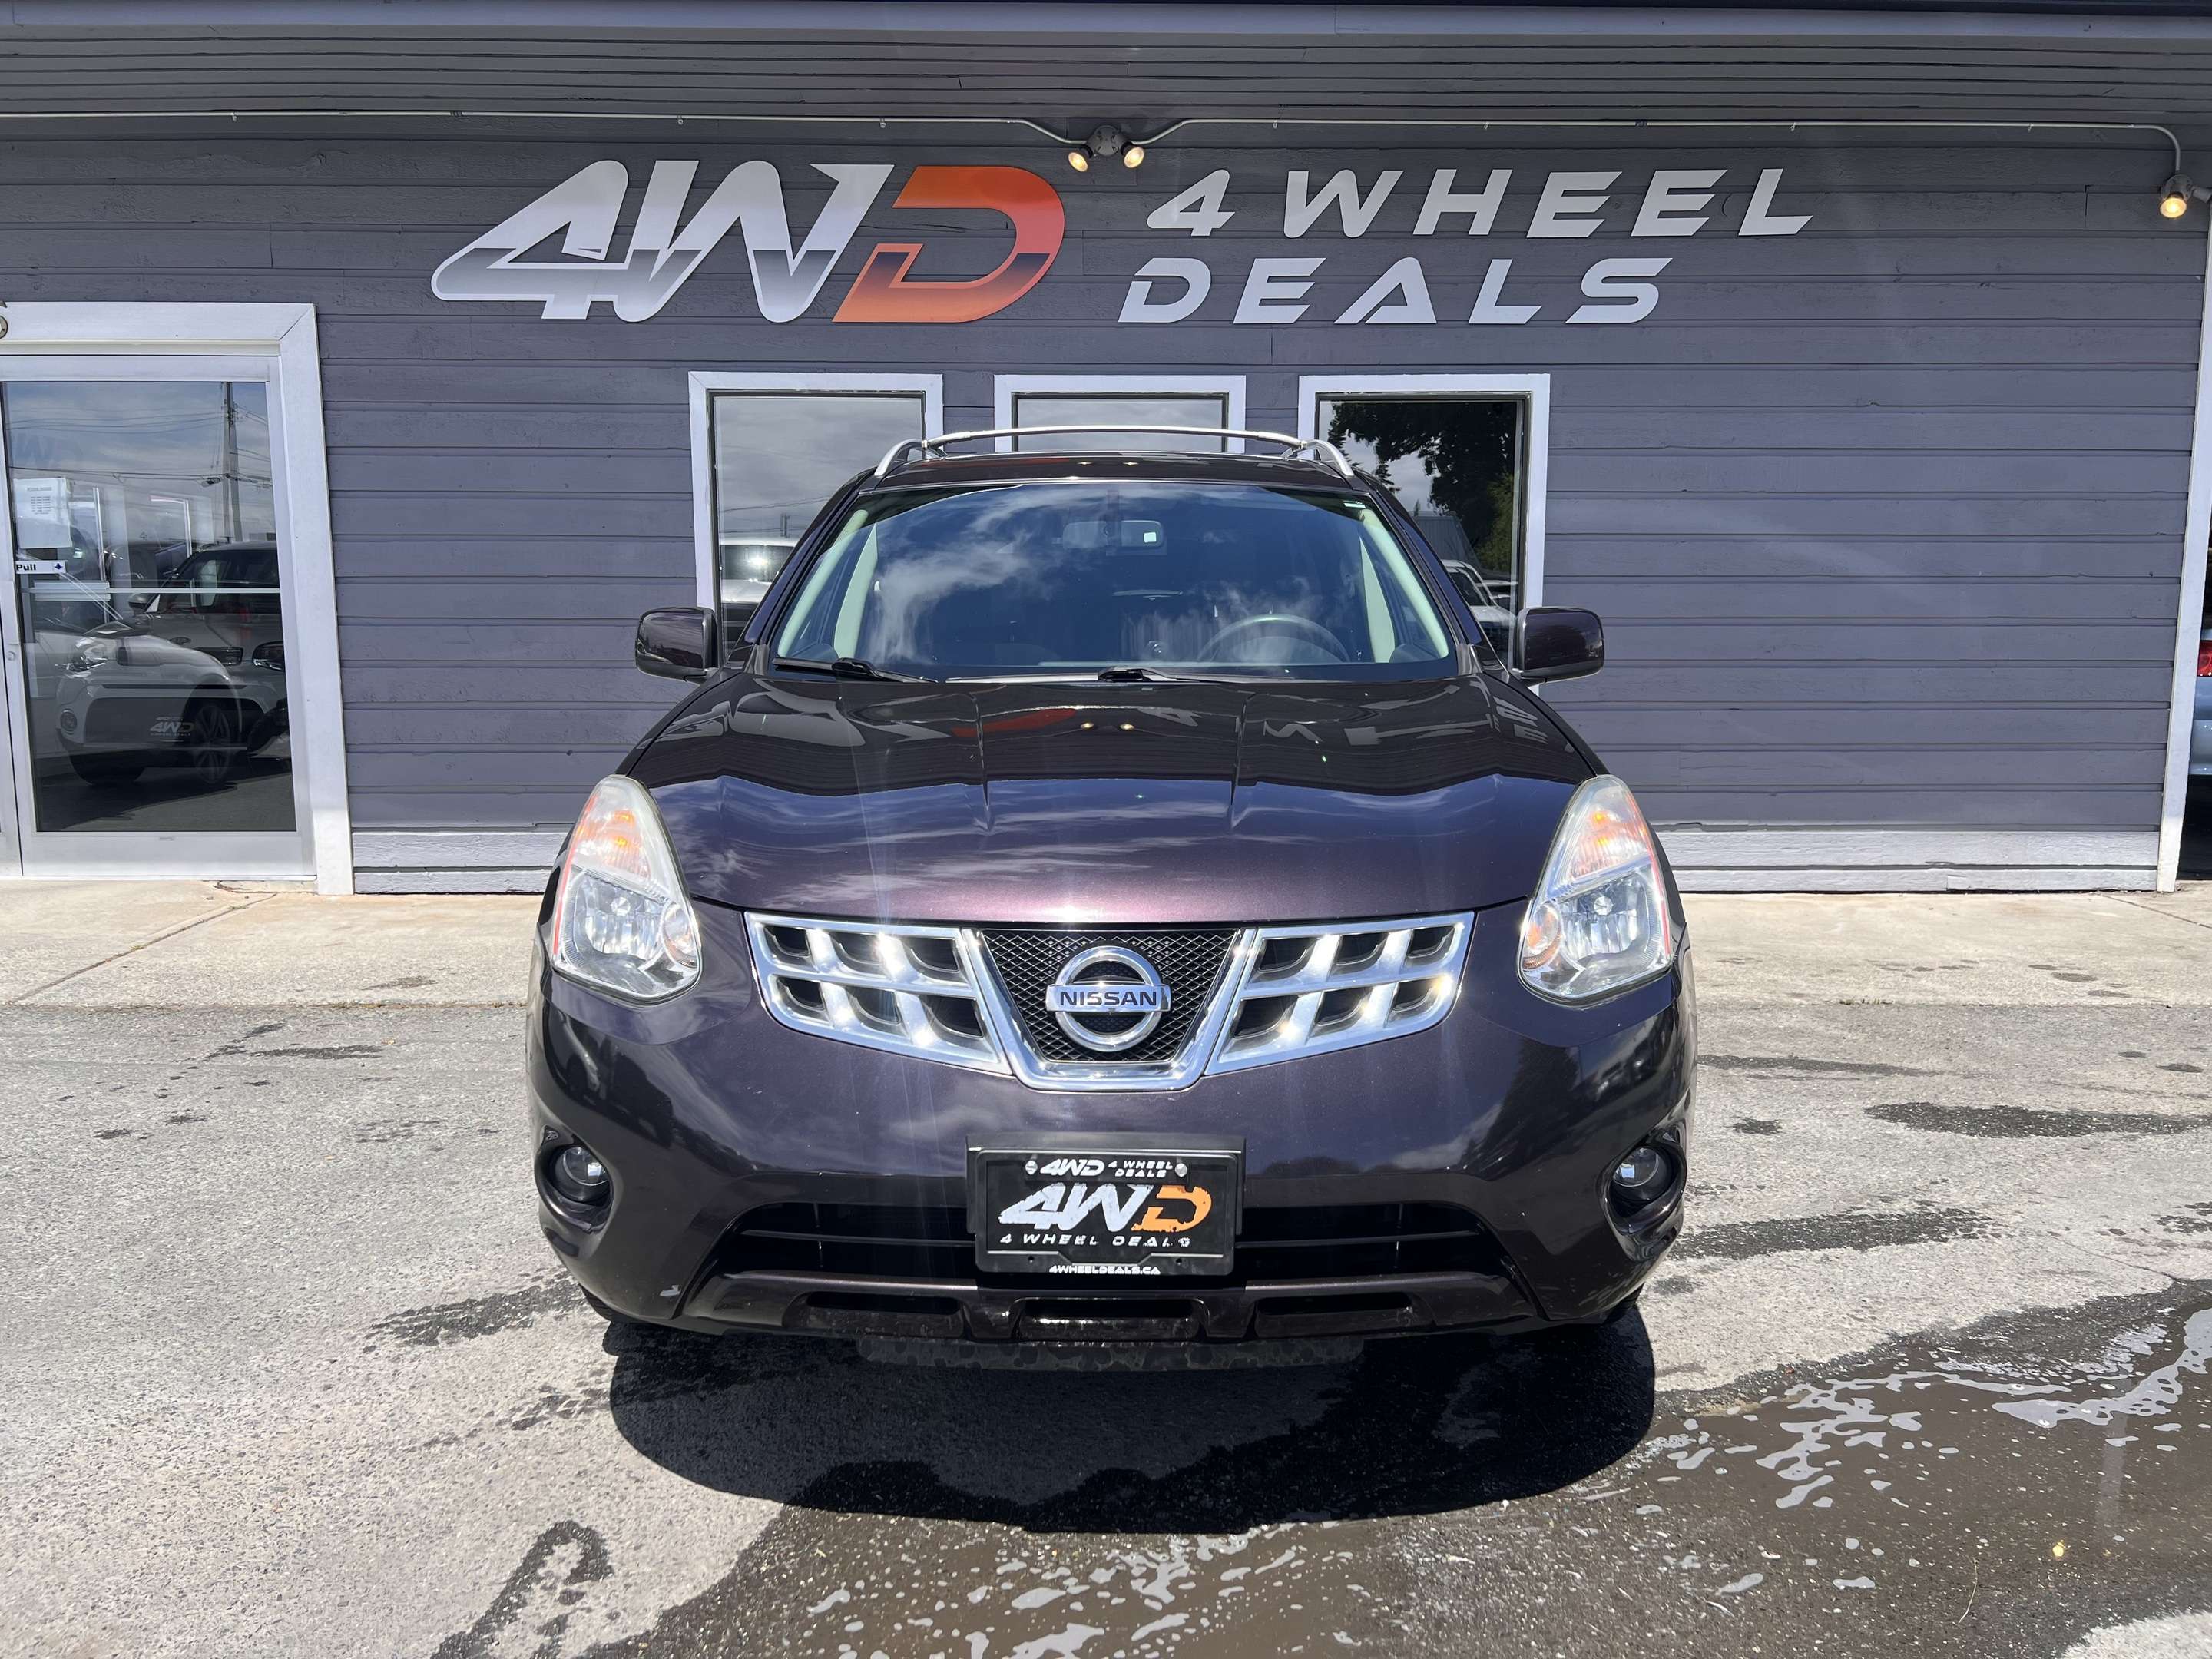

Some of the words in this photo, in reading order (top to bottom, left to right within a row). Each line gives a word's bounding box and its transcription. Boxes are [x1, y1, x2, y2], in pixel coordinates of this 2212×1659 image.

[1147, 169, 1236, 237] 4
[1283, 168, 1813, 238] WHEEL
[431, 160, 1066, 324] 4WD
[1118, 257, 1674, 324] DEALS
[1059, 991, 1157, 1006] NISSAN
[1040, 1158, 1105, 1177] 4WD
[1114, 1168, 1167, 1178] DEALS
[1123, 1160, 1174, 1170] WHEEL
[998, 1182, 1212, 1233] 4WD
[1000, 1233, 1012, 1243] 4
[1023, 1233, 1098, 1246] WHEEL
[1048, 1265, 1161, 1275] 4WHEELDEALS.CA
